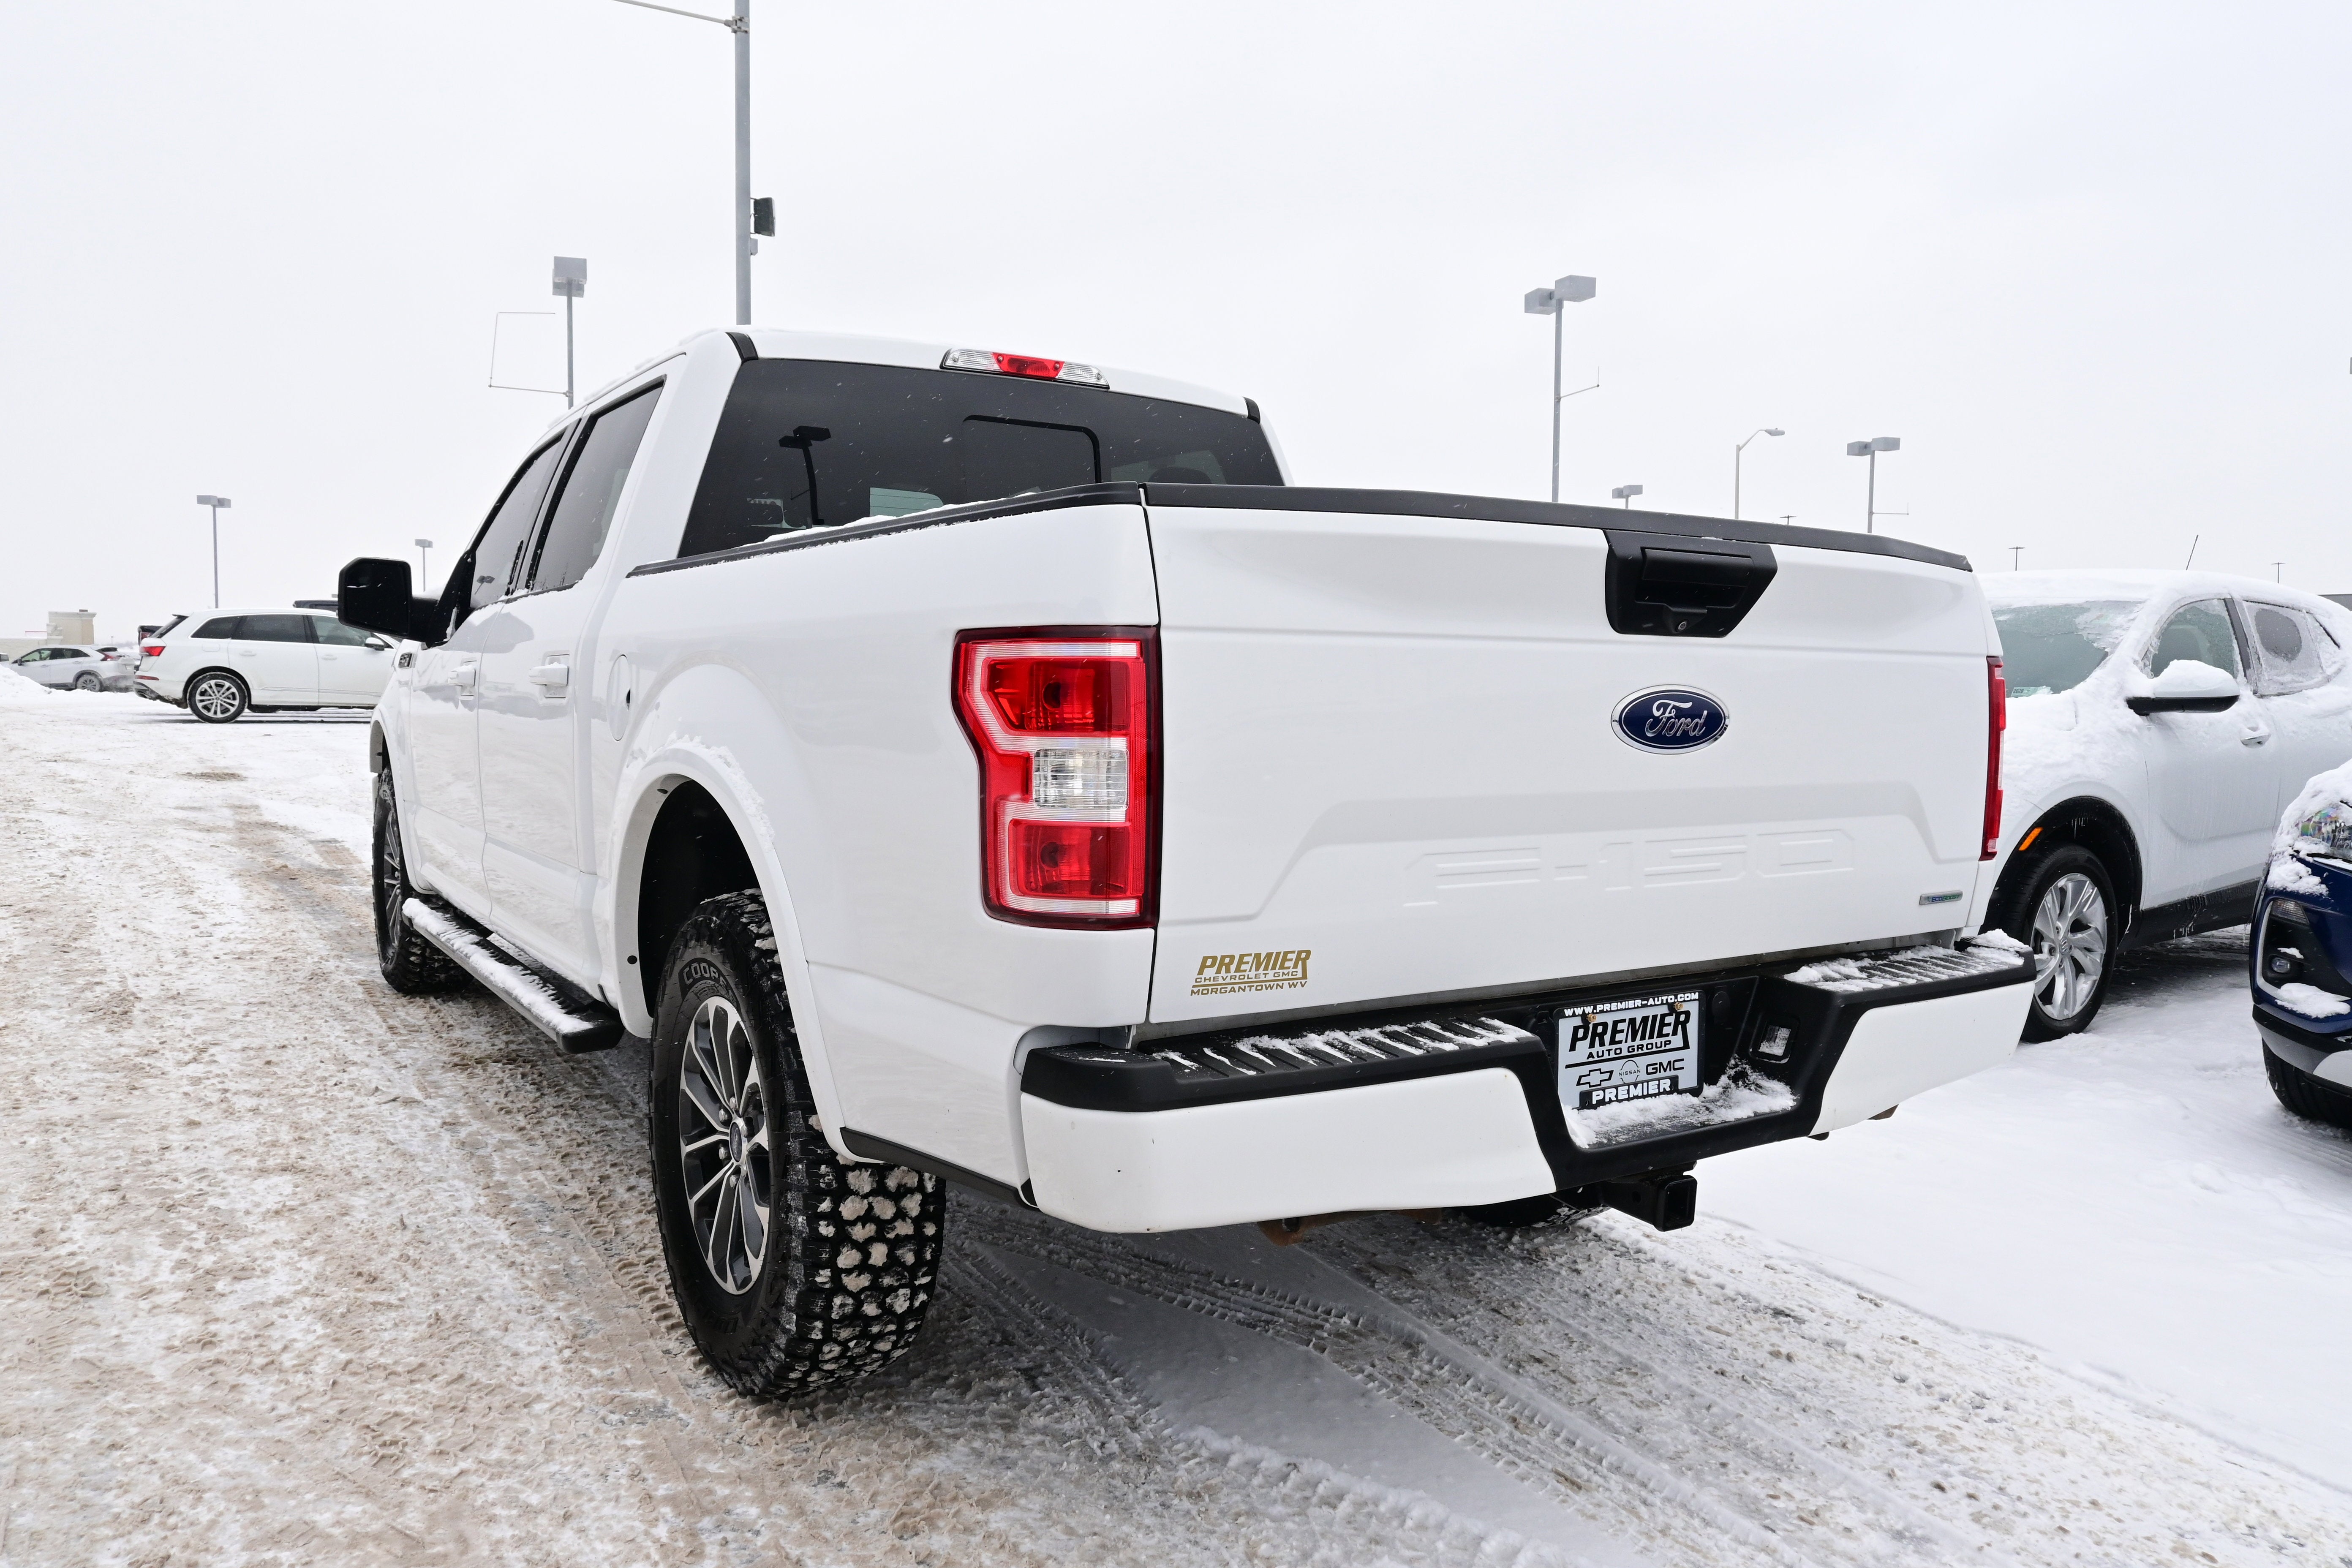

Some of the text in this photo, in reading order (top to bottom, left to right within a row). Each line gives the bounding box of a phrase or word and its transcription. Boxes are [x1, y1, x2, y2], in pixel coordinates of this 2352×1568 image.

[1645, 700, 1707, 737] Ford
[1403, 829, 1854, 907] F-150
[1197, 950, 1311, 979] PREMIER
[1190, 981, 1307, 996] MORGANTOWN WV
[1195, 972, 1269, 983] CHEVROLET
[1564, 992, 1699, 1016] WWW.PREMIER-AUTO.COM
[1568, 1010, 1691, 1052] PREMIER
[1586, 1040, 1671, 1060] AUTO GROUP
[1646, 1058, 1684, 1075] GMC
[1592, 1079, 1671, 1105] PREMIER
